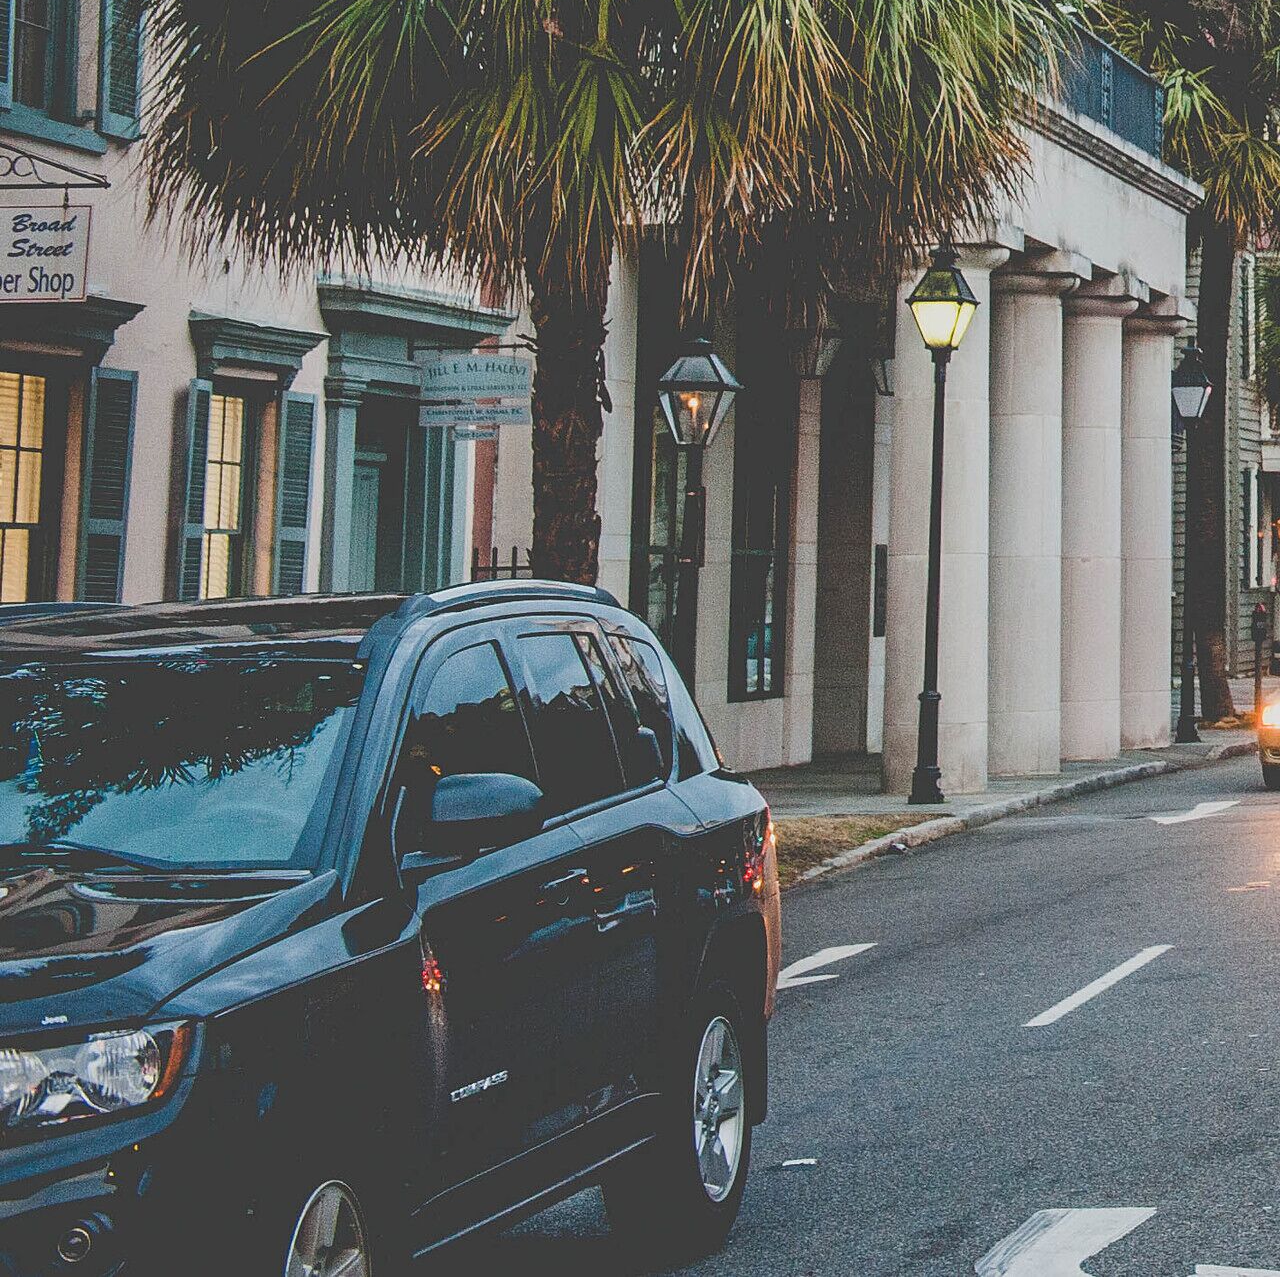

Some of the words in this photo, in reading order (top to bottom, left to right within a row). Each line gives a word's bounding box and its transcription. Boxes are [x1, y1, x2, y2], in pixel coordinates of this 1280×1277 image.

[11, 213, 77, 233] Broad
[7, 238, 73, 257] Street
[0, 273, 22, 293] er
[28, 266, 74, 299] Shop
[450, 1070, 508, 1102] COMPASS
